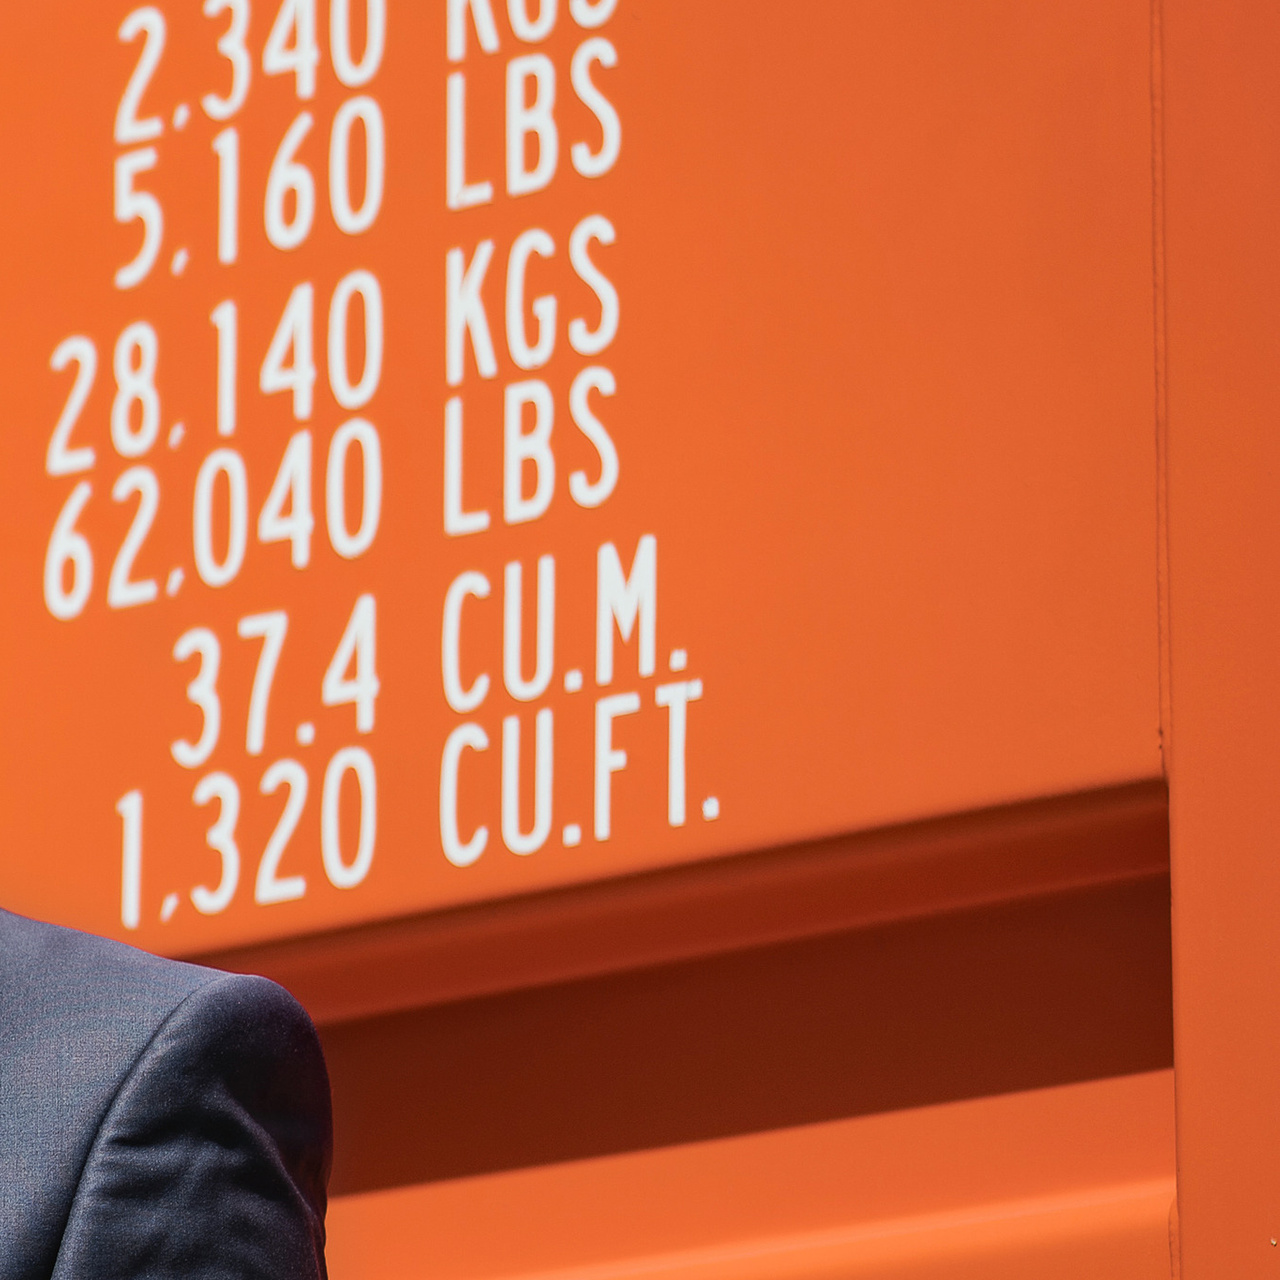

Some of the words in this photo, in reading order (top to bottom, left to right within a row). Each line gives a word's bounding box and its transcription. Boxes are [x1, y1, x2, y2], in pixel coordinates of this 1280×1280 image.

[445, 35, 623, 211] LBS
[445, 213, 621, 387] KGS
[442, 364, 621, 537] LBS
[170, 592, 382, 769] 37.4
